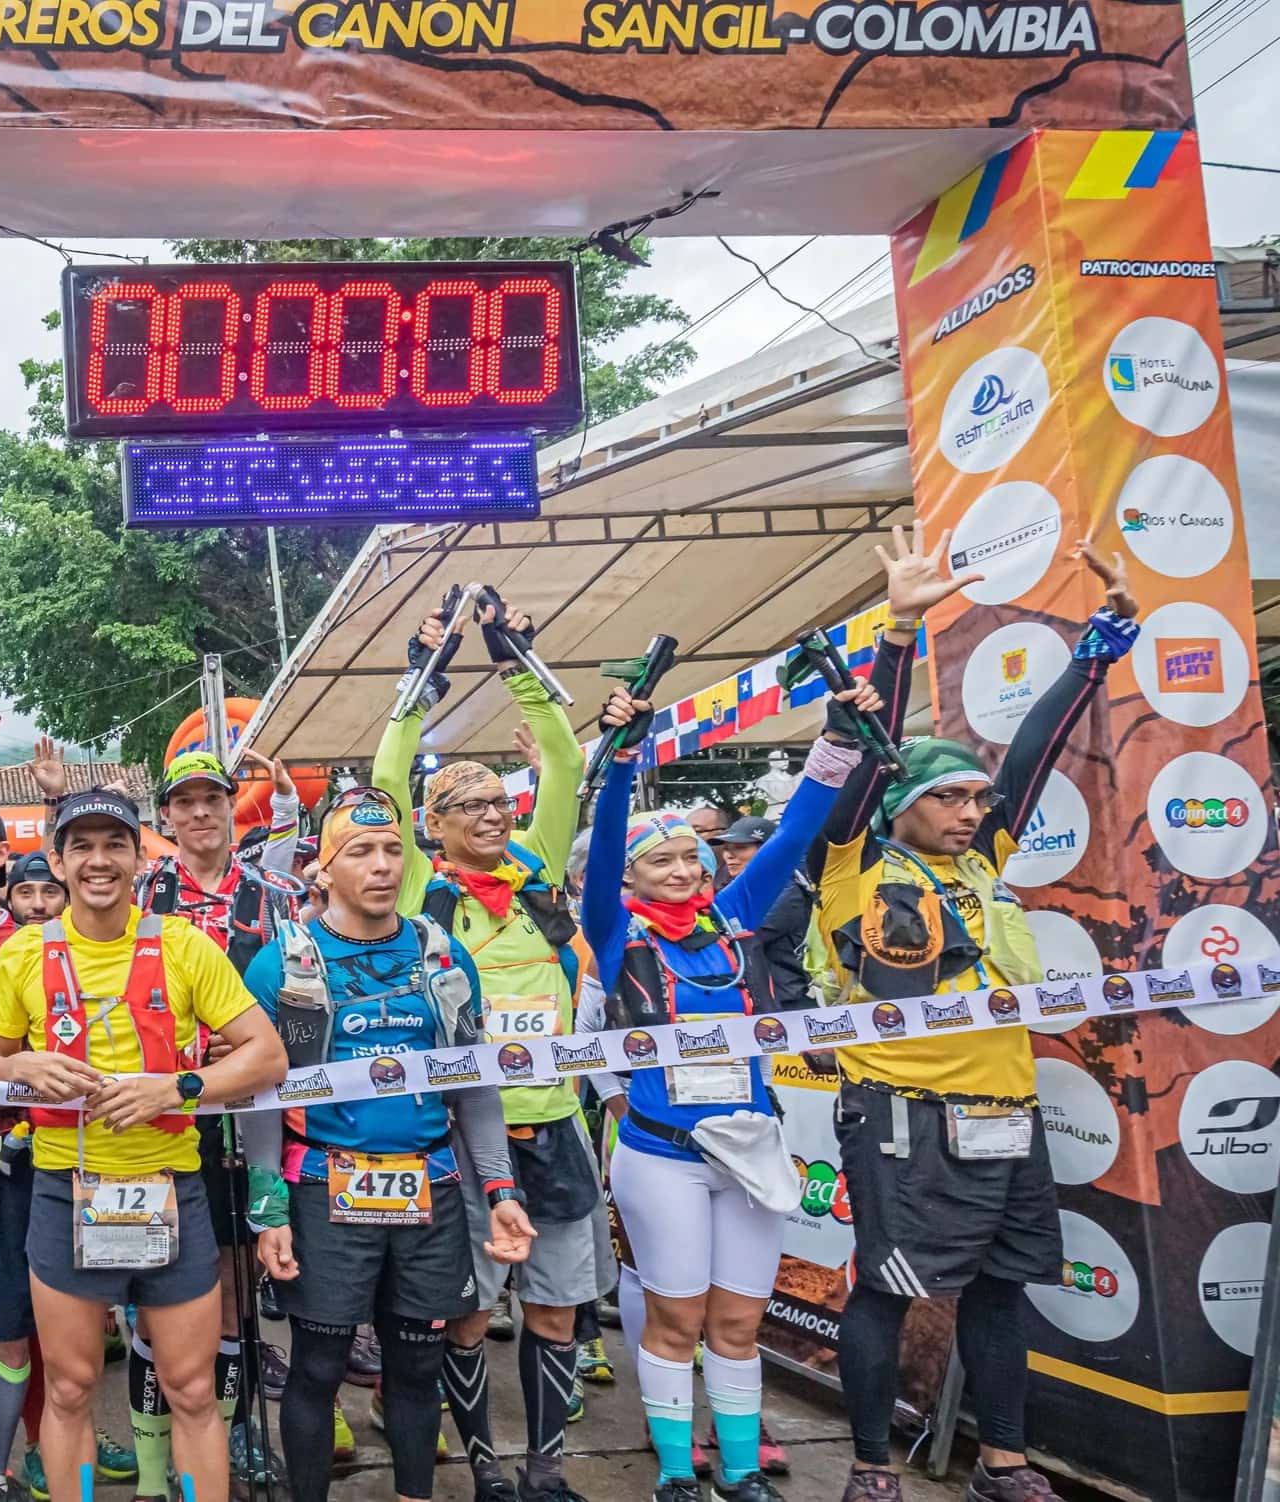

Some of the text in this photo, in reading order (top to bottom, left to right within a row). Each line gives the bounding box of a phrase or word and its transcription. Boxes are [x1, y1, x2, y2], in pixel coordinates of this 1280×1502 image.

[180, 0, 280, 46] DEL
[934, 266, 1033, 341] ALIADOS:
[87, 277, 561, 415] 00:00:00
[1139, 358, 1174, 368] HOTEL
[1143, 372, 1214, 391] AGUALUNA
[1139, 512, 1165, 527] RIOS
[1179, 513, 1224, 527] CANOAS
[1164, 650, 1215, 669] PEOPLE
[71, 803, 124, 816] SUUNTO
[1170, 803, 1242, 820] Connect 4
[500, 1012, 545, 1034] 166
[675, 1025, 729, 1050] CHICAMOCHA
[552, 1038, 606, 1065] CHICAMOCHA
[425, 1051, 480, 1078] CHICAMOCHA
[8, 1081, 45, 1098] CHICA
[1041, 1105, 1066, 1116] OTEL
[1043, 1119, 1113, 1146] GUALUNA
[1189, 1137, 1268, 1155] Julbo
[355, 1172, 418, 1198] 478
[116, 1186, 147, 1210] 12
[1063, 1266, 1096, 1286] nect
[766, 1298, 840, 1341] ICAMOCH
